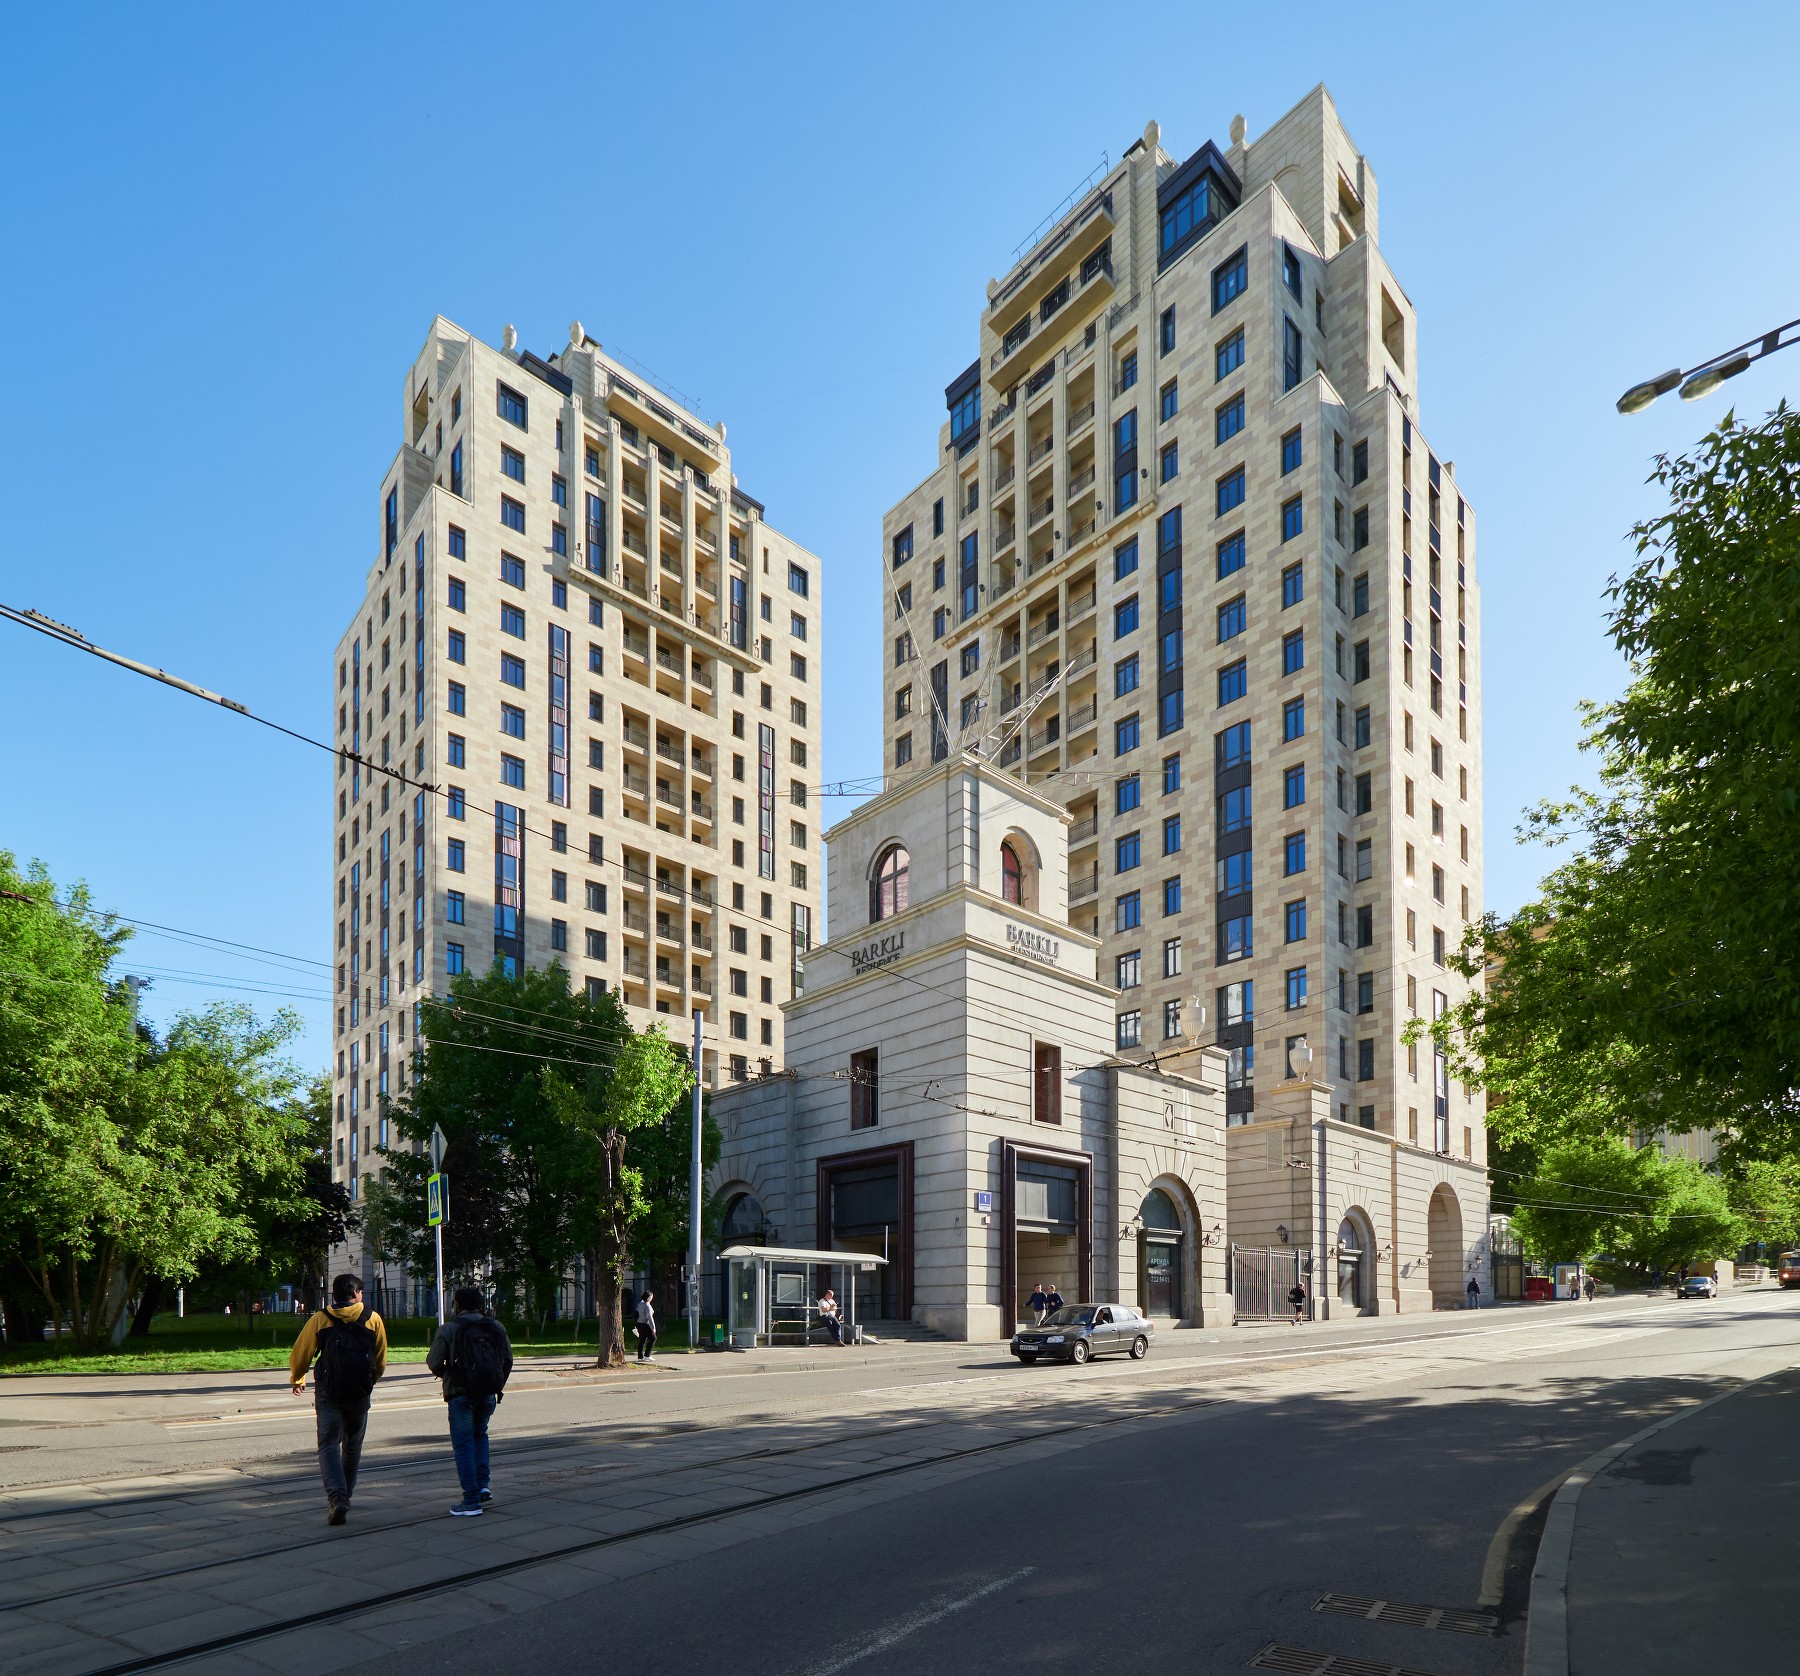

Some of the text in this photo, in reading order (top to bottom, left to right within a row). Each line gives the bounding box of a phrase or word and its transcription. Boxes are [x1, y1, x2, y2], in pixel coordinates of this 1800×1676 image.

[851, 931, 904, 967] BARKLI
[1006, 924, 1060, 959] BARKLI
[984, 1194, 987, 1203] 1
